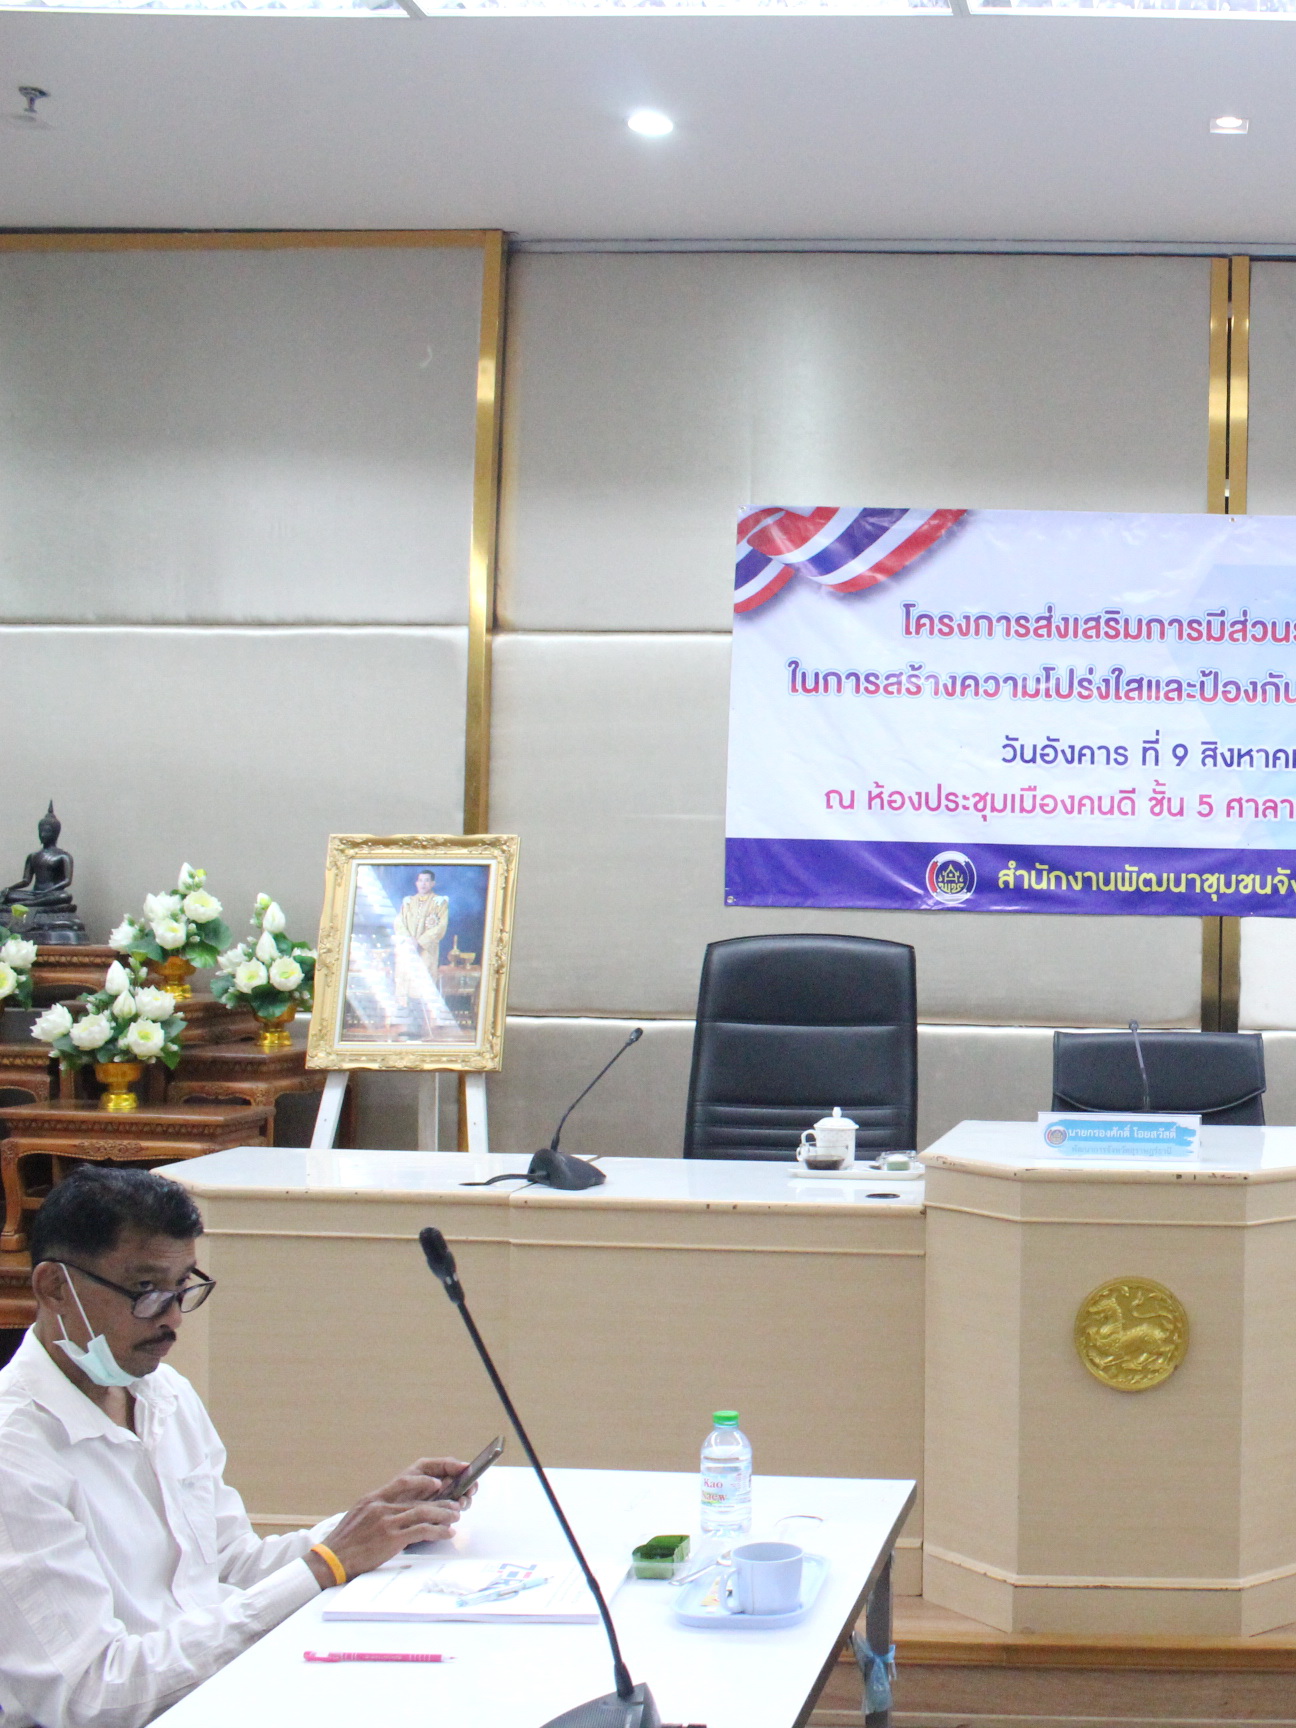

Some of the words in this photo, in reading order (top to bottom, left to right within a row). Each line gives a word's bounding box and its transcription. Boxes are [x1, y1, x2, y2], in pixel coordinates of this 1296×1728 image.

[1002, 735, 1129, 766] วันอังคาร
[1141, 730, 1160, 767] ที่
[1172, 747, 1189, 767] 9
[825, 787, 856, 811] ณ
[867, 780, 1136, 821] ห้องประชุมเมืองคนดี
[1148, 779, 1185, 818] ชั้น
[1197, 794, 1215, 818] 5
[704, 1478, 723, 1489] Kao
